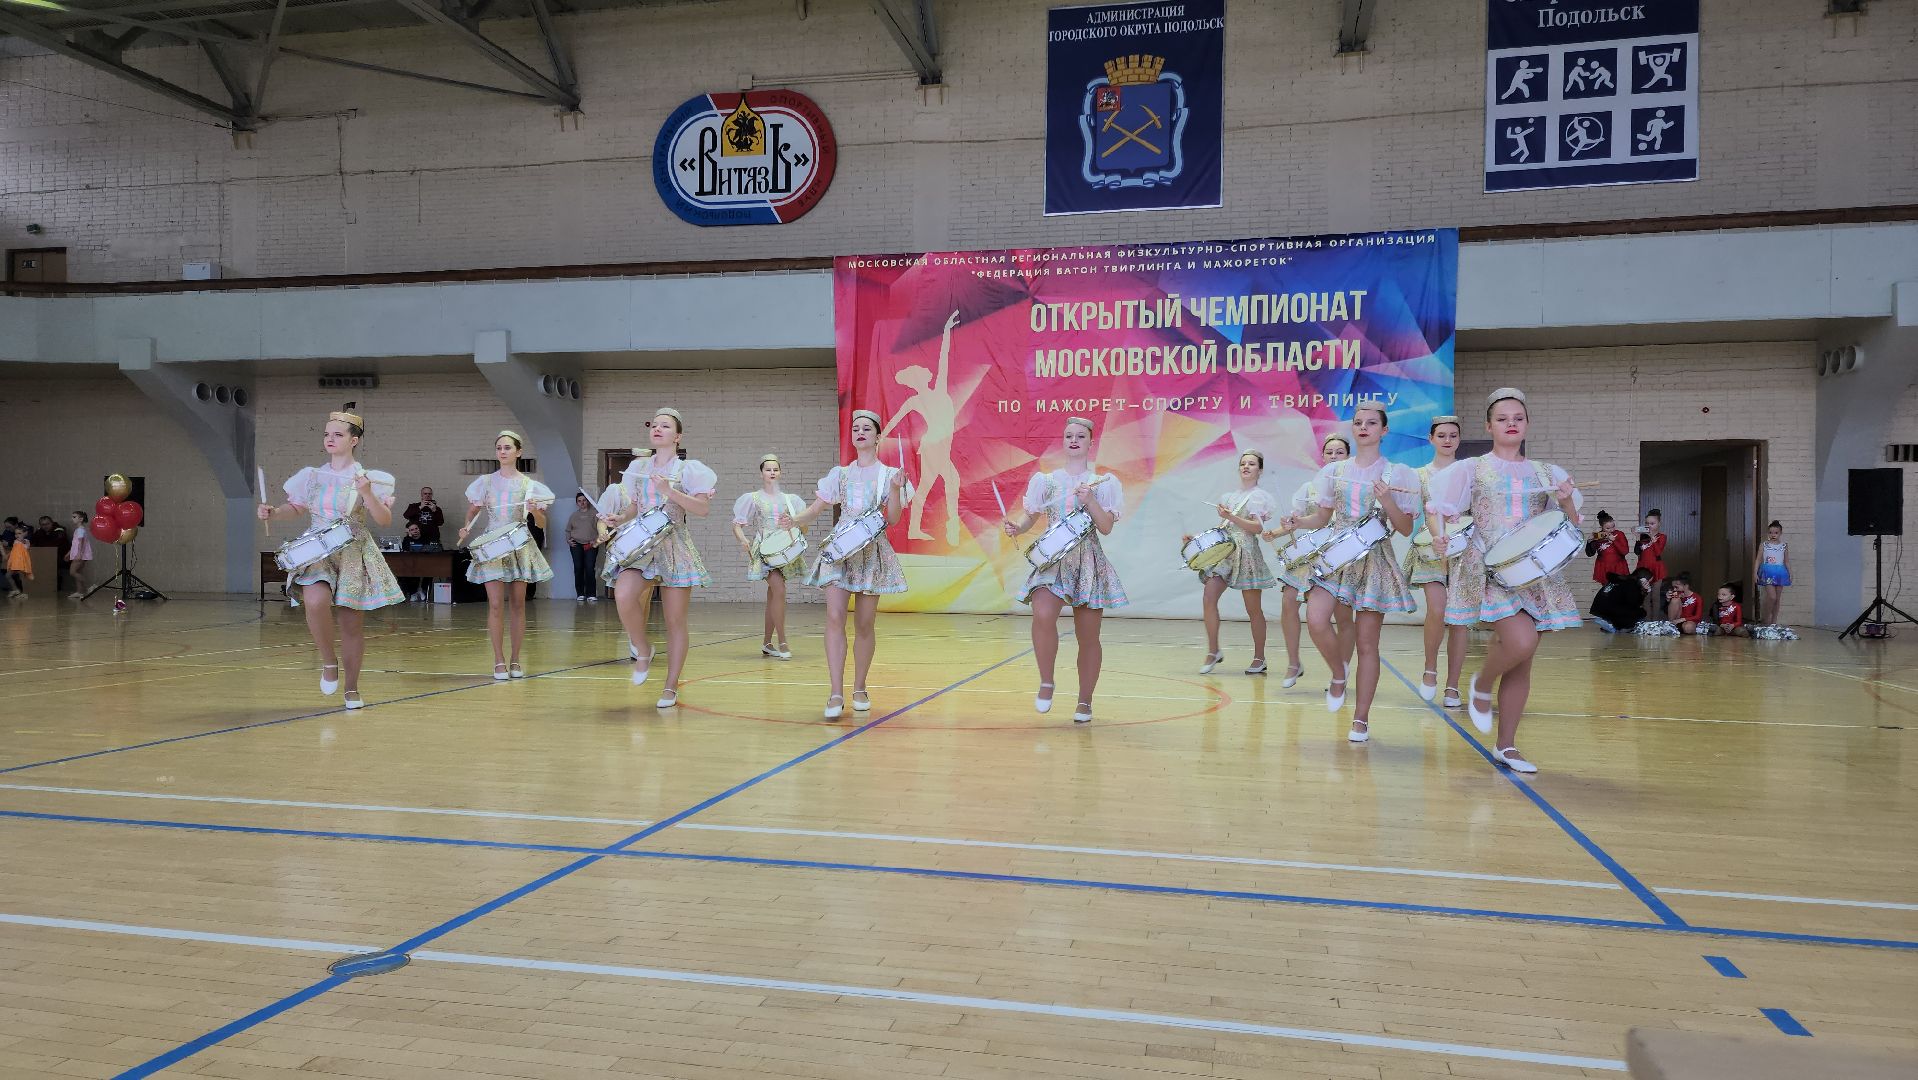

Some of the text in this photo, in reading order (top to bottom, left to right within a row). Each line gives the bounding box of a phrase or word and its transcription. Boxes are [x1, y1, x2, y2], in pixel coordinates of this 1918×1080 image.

[1086, 5, 1185, 25] АДМИНИСТРАЦИЯ
[1537, 5, 1646, 28] Подольск
[1048, 17, 1225, 42] ГОРОДСКОГО ОКРУГА ПОДОЛЬСК
[848, 234, 1436, 269] МОСКОВСКАЯ ОБЛАСТНАЯ РЕГИОНАЛЬНАЯ ФИЗКУЛЬТУРНО-СПОРТИВНАЯ ОРГАНИЗАЦИЯ
[971, 268, 1050, 279] "ФЕДЕРАЦИЯ
[1103, 262, 1181, 273] ТВИРЛИНГА
[1187, 261, 1196, 270] И
[1203, 257, 1292, 269] МАЖОРЕТОК"
[1030, 290, 1367, 333] ОТКРЫТЫЙ ЧЕМПИОНАТ
[1035, 339, 1361, 378] МОСКОВСКОЙ ОБЛАСТИ
[998, 399, 1021, 413] ПО
[1240, 395, 1251, 410] И
